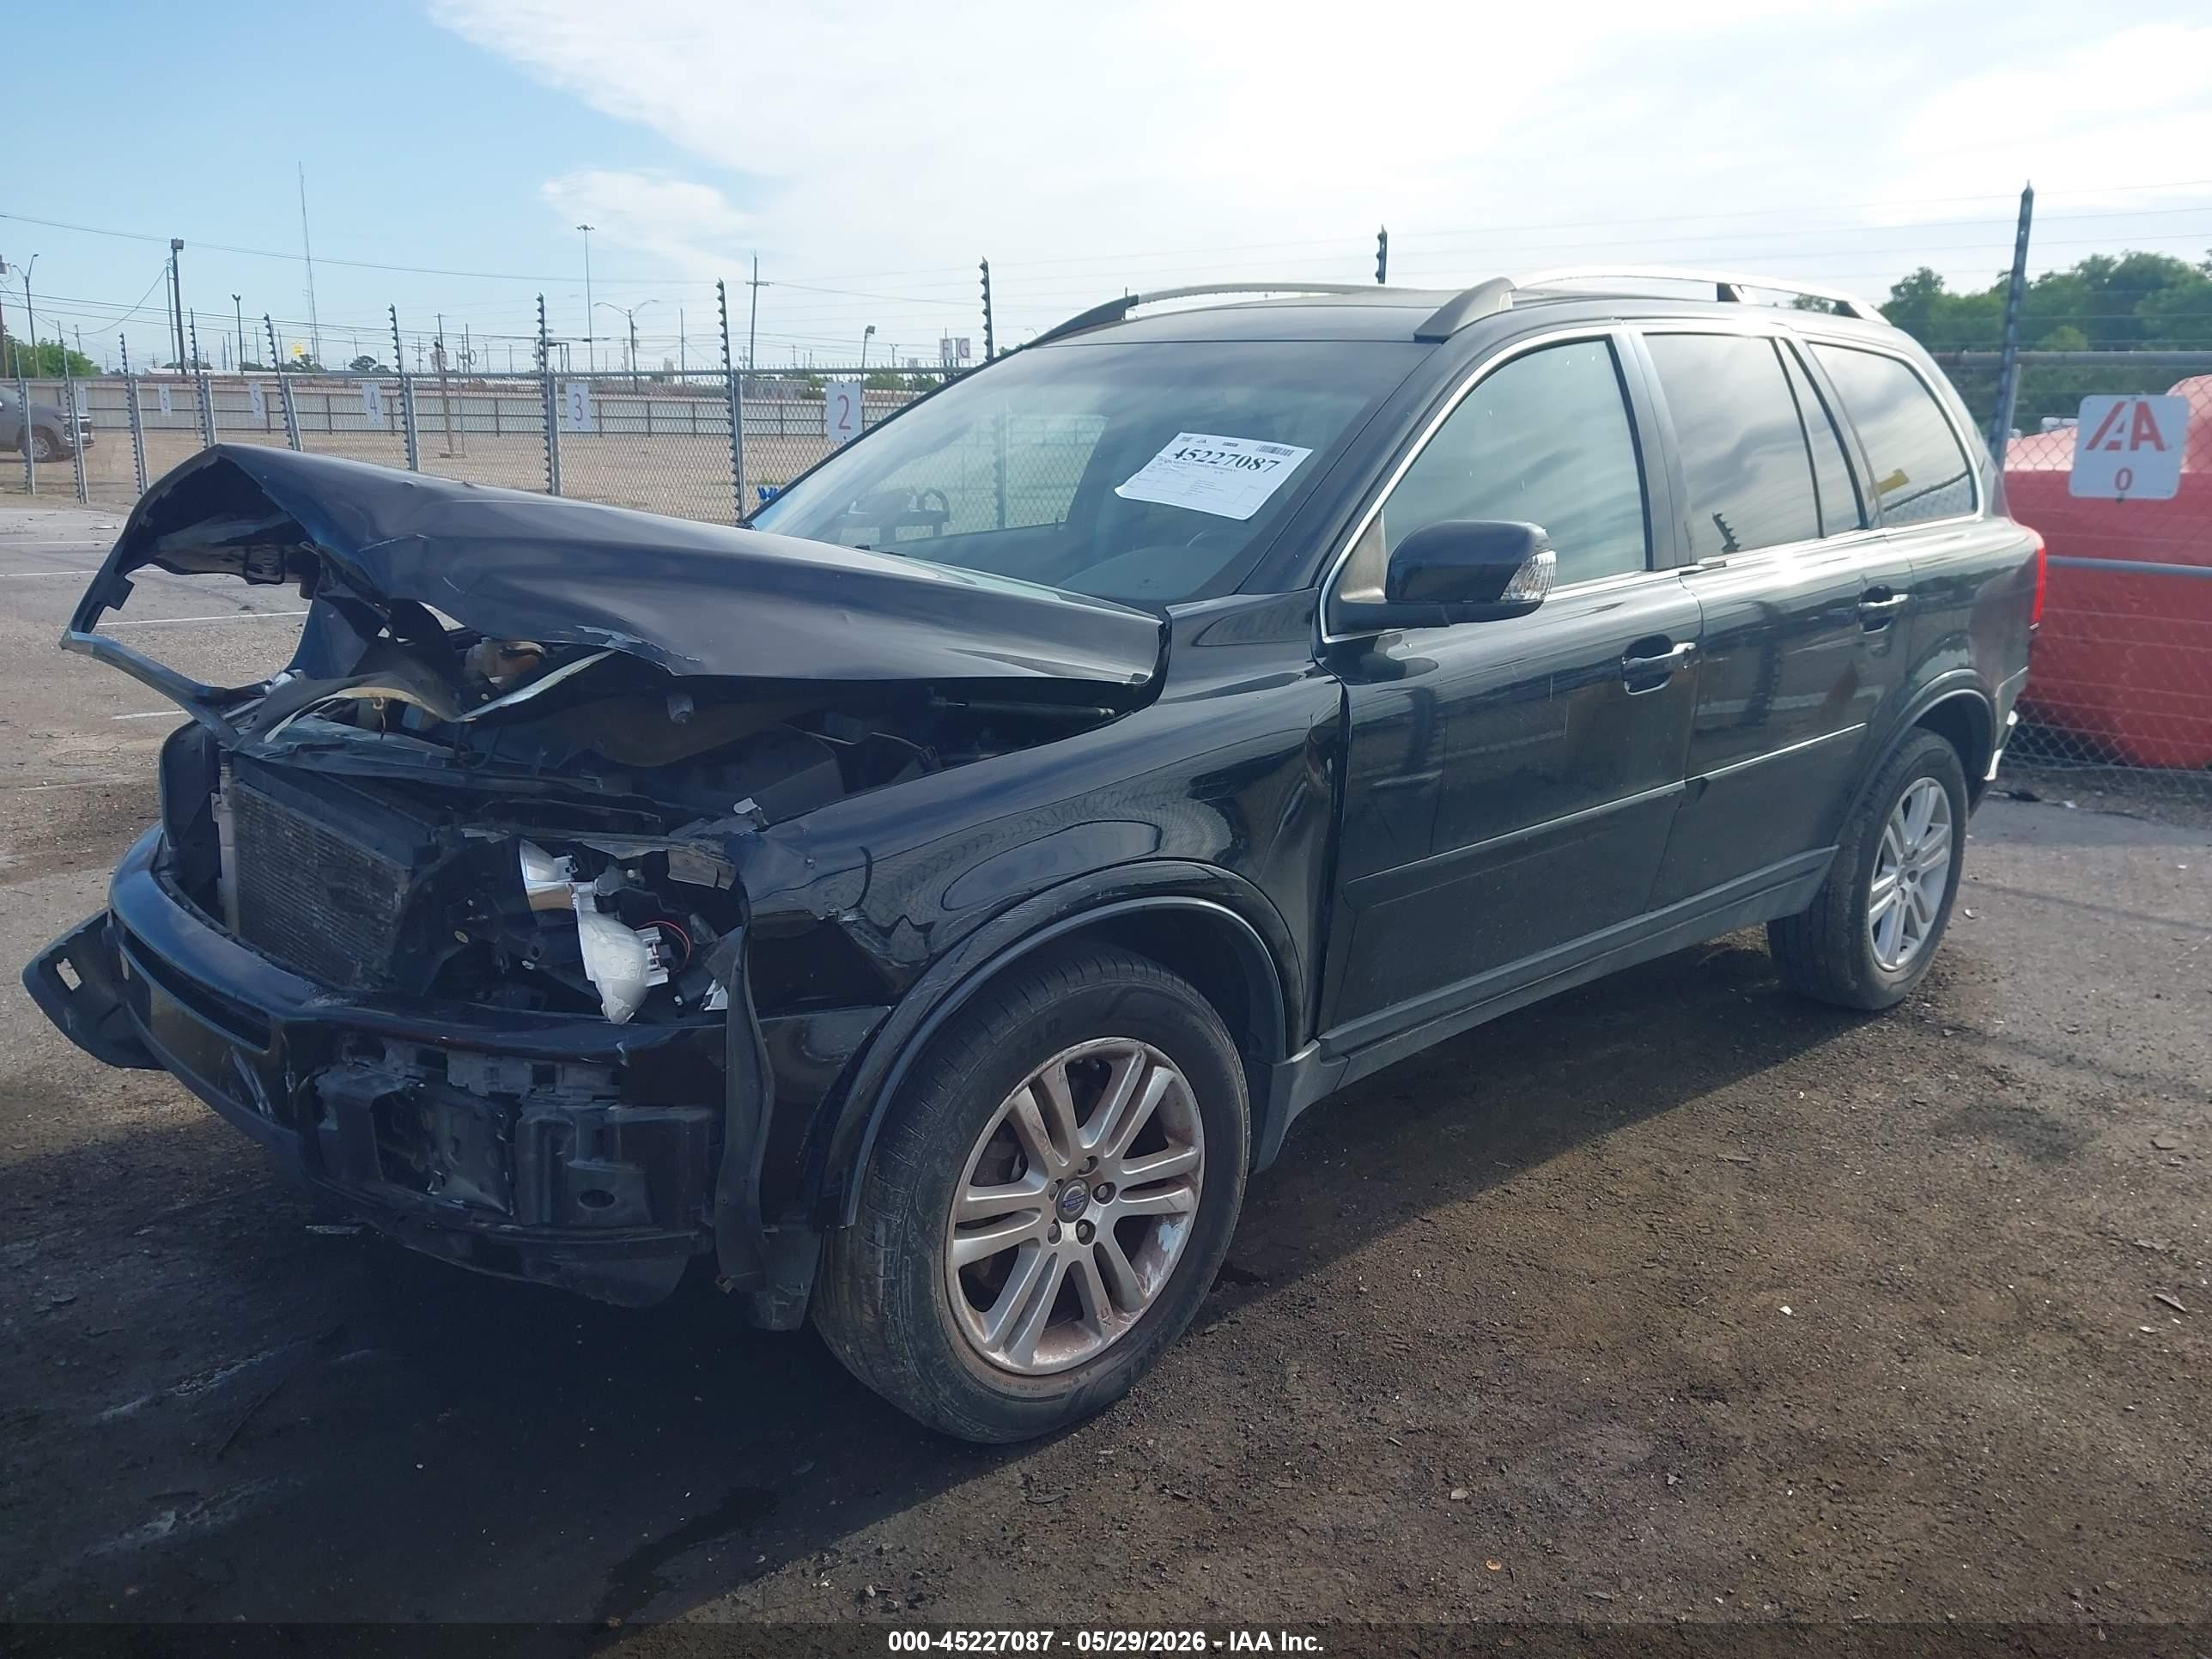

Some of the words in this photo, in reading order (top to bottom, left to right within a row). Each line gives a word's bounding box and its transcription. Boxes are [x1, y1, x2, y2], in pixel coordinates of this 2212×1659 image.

[369, 391, 378, 415] 4
[574, 393, 584, 422] 3
[838, 394, 852, 430] 2
[1174, 447, 1281, 472] 45227087
